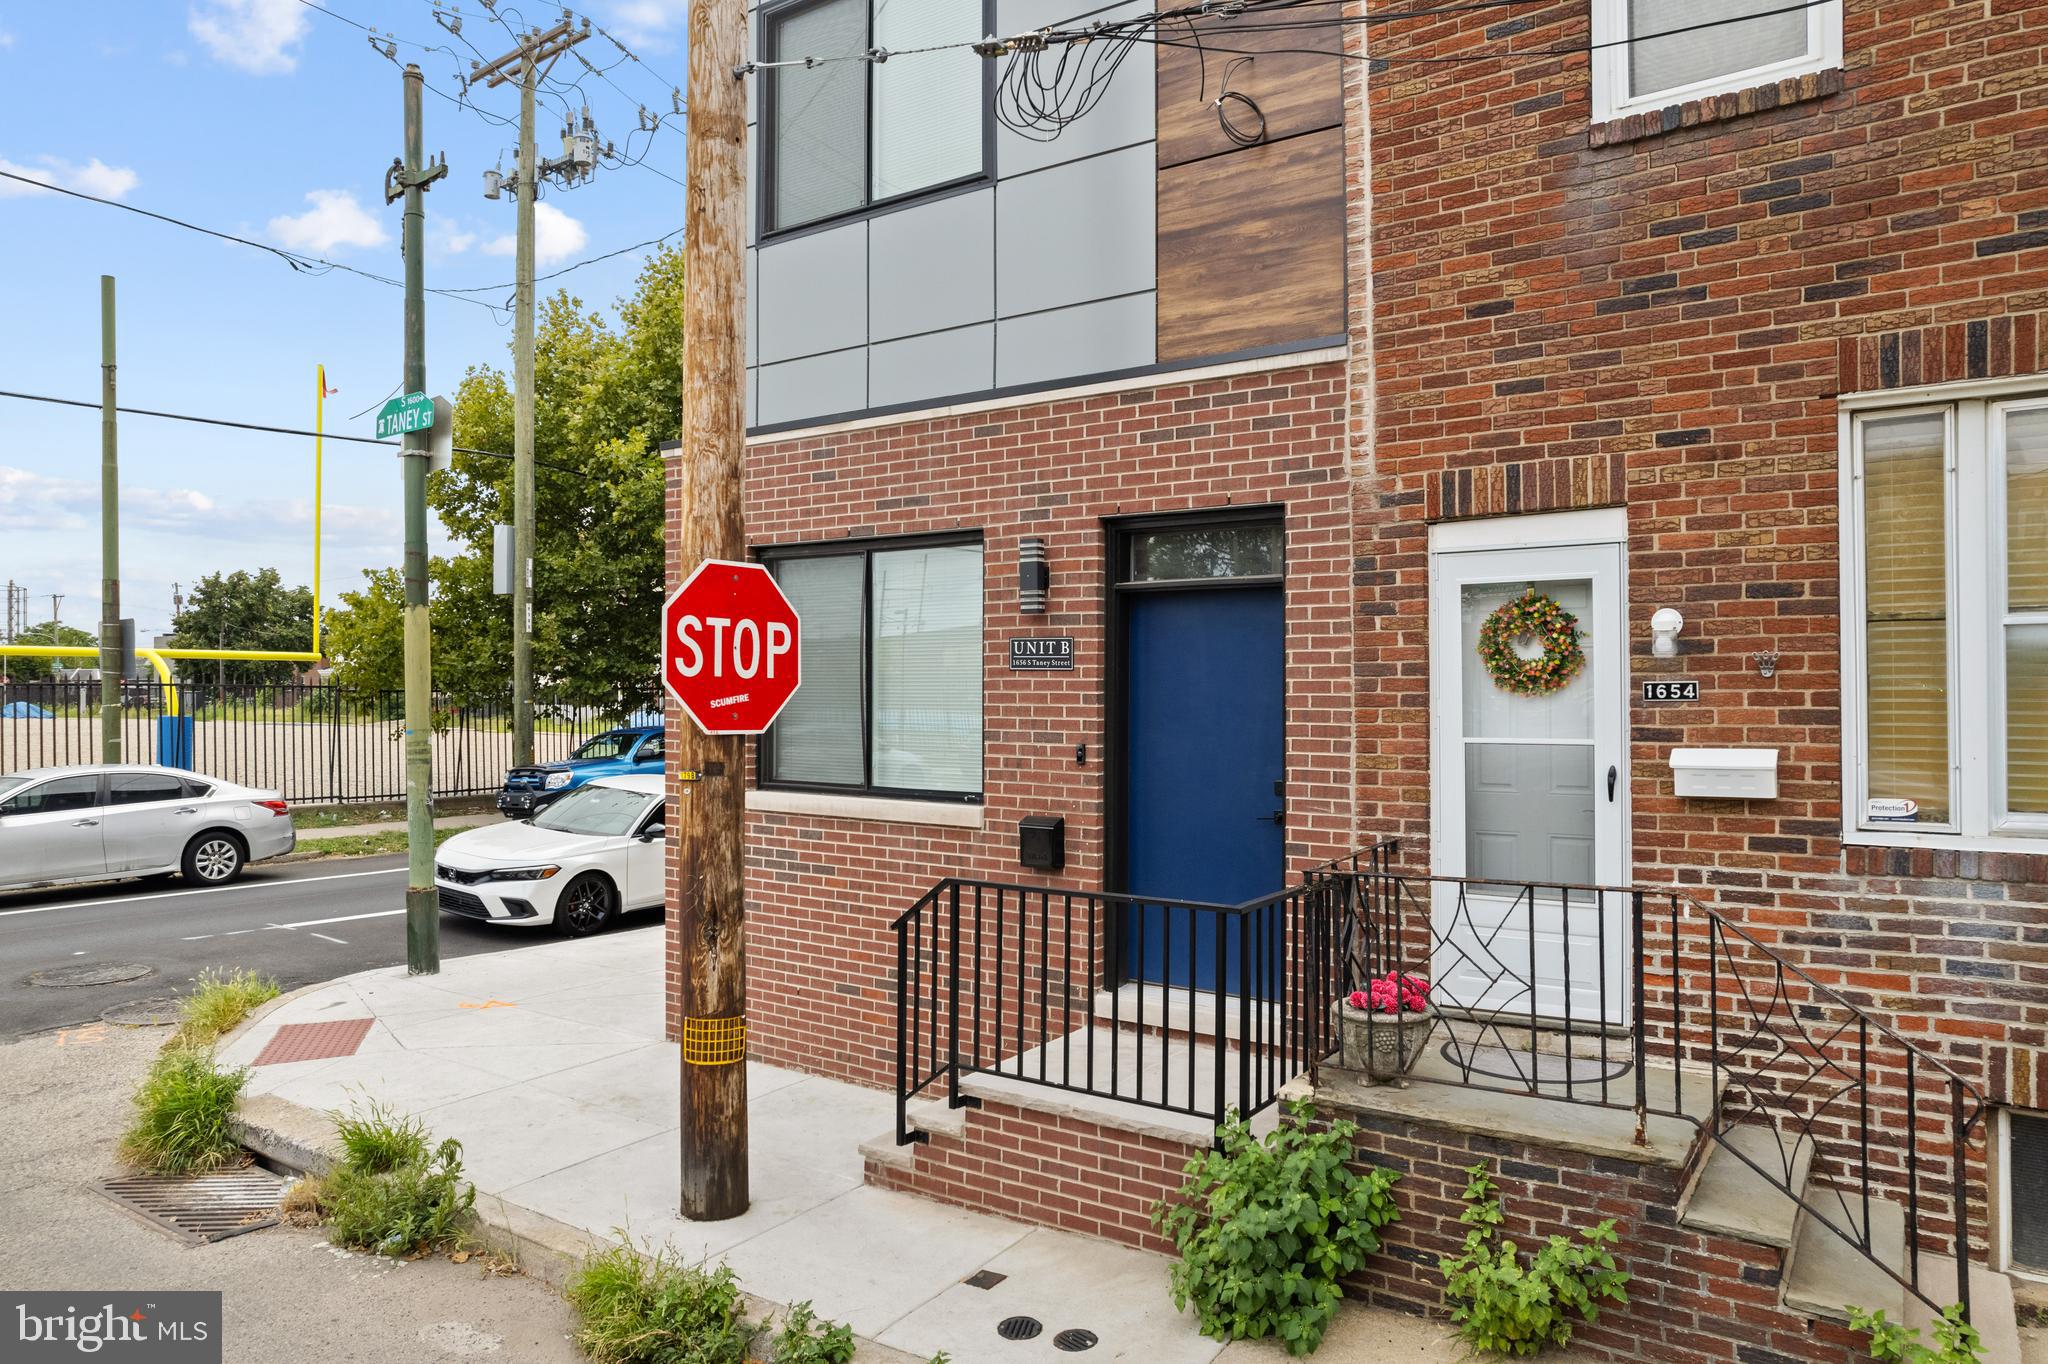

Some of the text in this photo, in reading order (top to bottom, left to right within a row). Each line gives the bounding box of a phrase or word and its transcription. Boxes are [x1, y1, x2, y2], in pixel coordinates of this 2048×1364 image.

[401, 397, 406, 407] S
[387, 408, 432, 434] TANEY ST
[675, 614, 792, 680] STOP
[1013, 641, 1070, 654] UNIT B
[1032, 659, 1050, 668] Taney
[1646, 684, 1695, 698] 1654
[710, 693, 750, 709] SCUMFIRE
